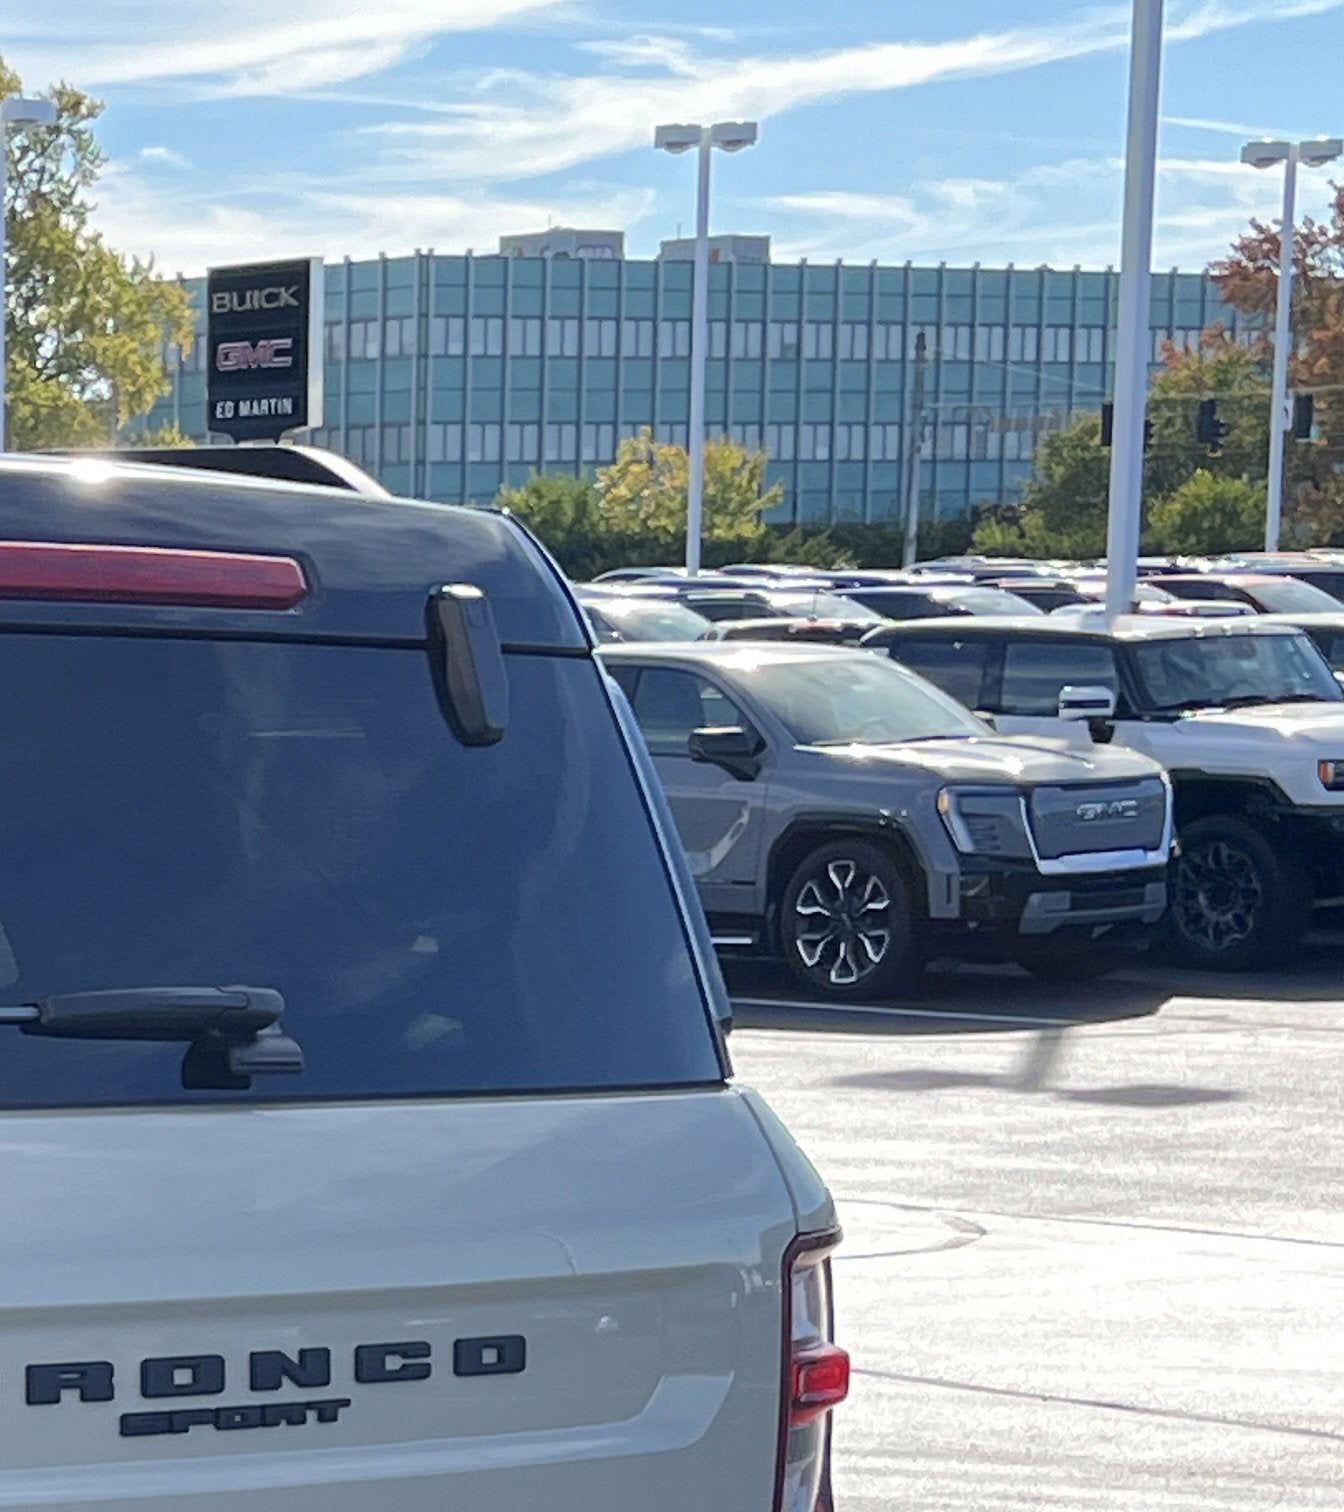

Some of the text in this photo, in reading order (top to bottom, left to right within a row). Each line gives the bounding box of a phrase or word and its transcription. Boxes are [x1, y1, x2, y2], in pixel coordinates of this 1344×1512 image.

[212, 285, 300, 313] BUICK
[216, 337, 293, 372] GMC
[216, 397, 293, 419] ED MARTIN
[119, 1397, 352, 1437] SPORT
